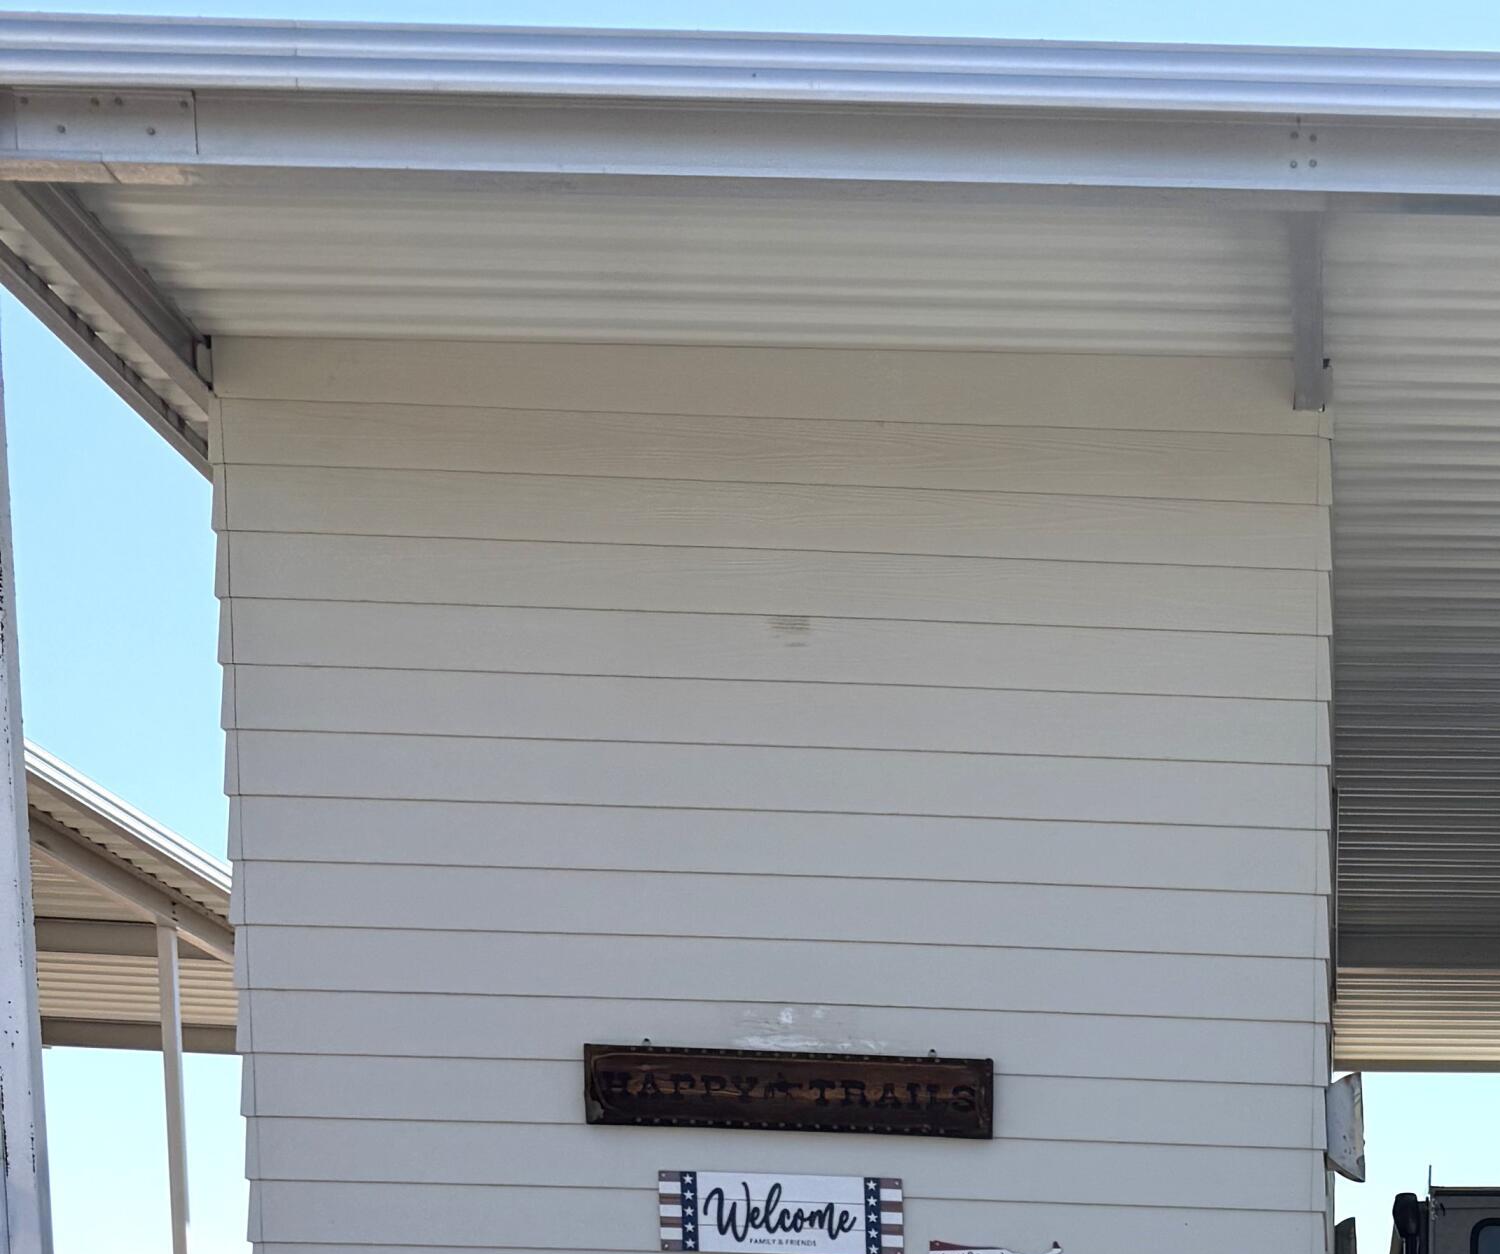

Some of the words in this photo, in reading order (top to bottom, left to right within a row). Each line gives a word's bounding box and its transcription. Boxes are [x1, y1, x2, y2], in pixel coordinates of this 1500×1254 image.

[600, 1070, 760, 1100] HAPPY
[809, 1078, 978, 1112] TRAILS
[702, 1181, 858, 1241] Welcome
[785, 1239, 817, 1247] FRIENDS
